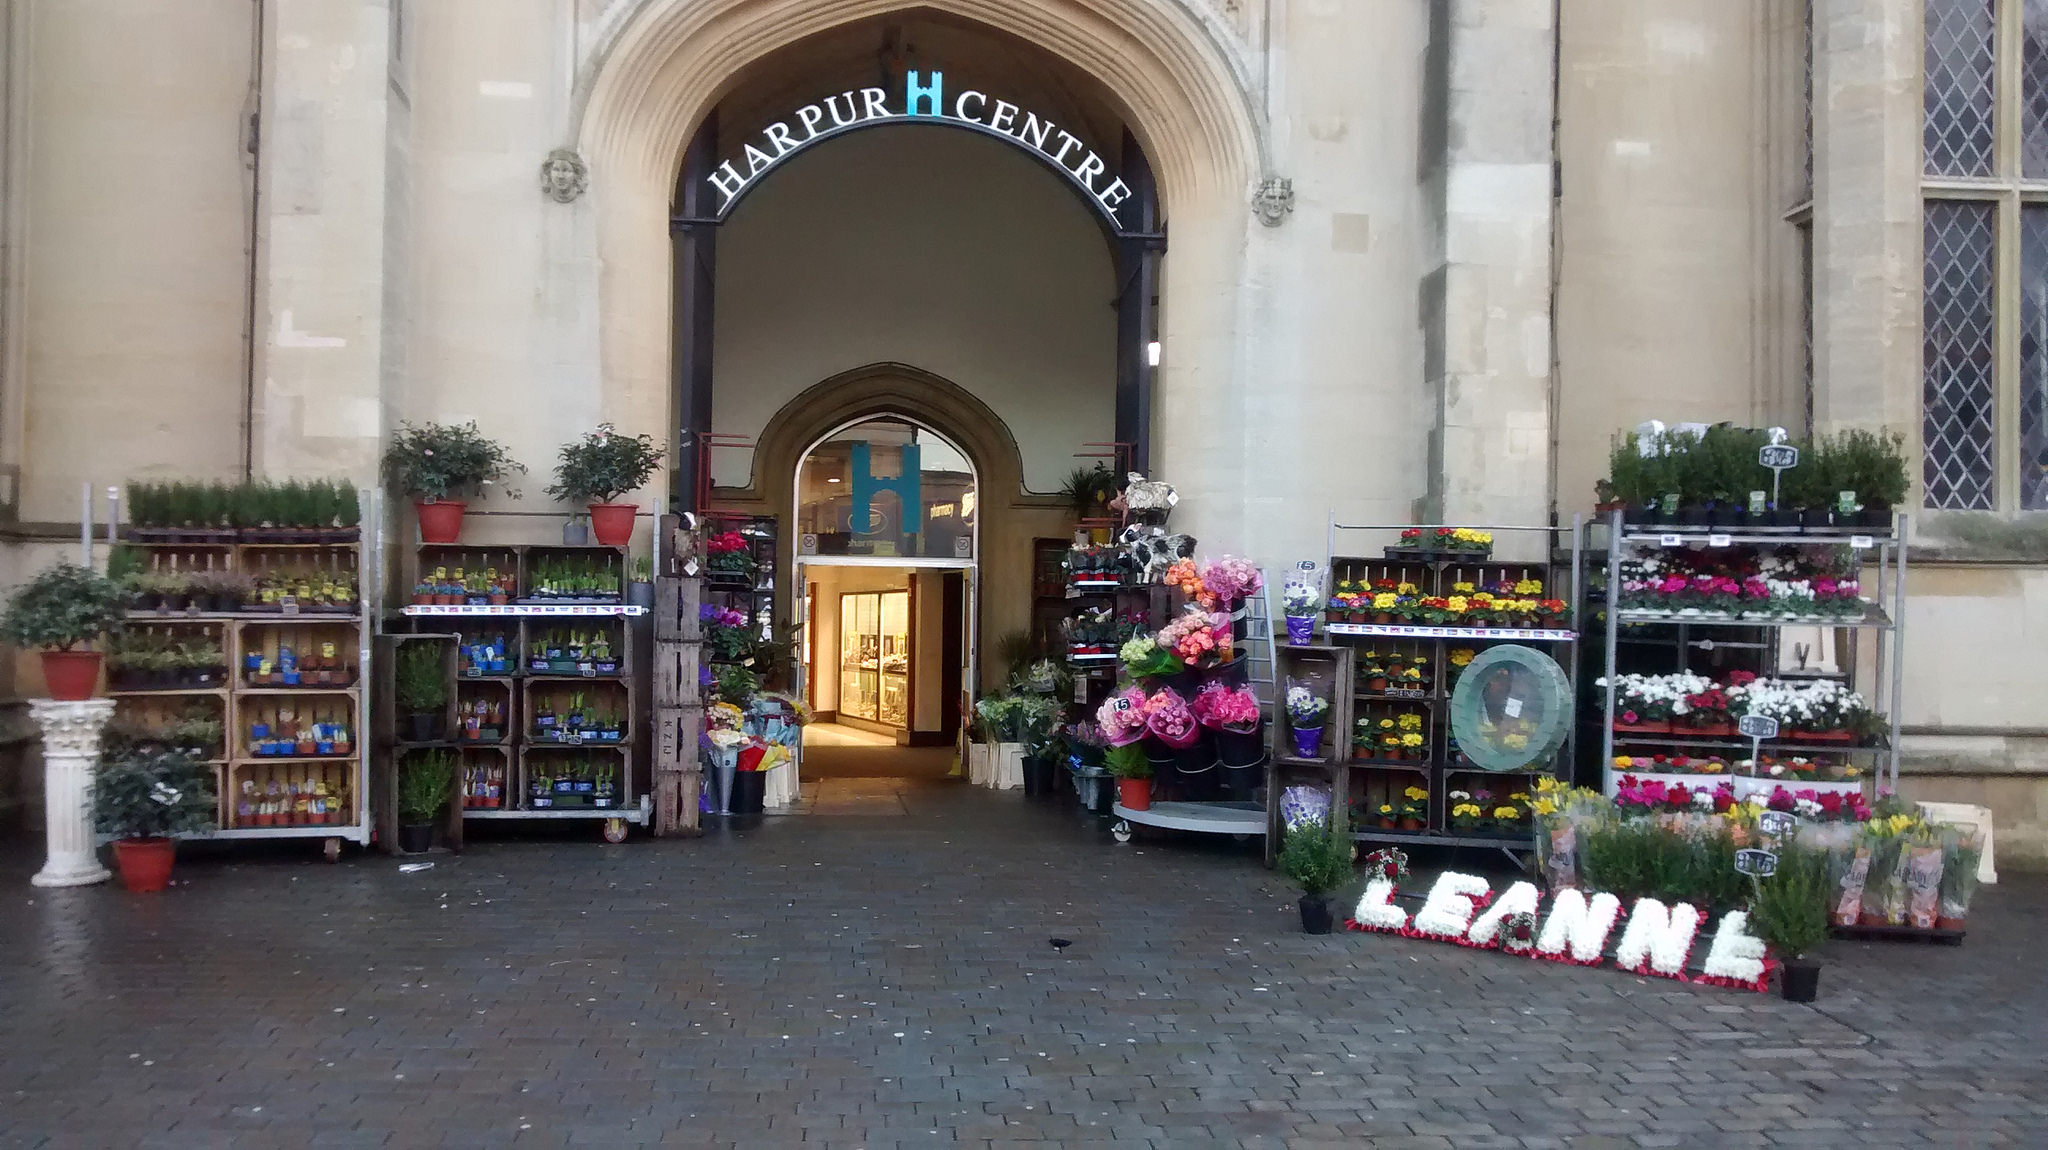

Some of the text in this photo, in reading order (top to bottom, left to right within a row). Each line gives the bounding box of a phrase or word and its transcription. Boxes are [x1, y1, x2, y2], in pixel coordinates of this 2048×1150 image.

[707, 86, 894, 202] HARPUR
[955, 89, 1133, 214] CENTRE
[1114, 699, 1128, 712] 15
[1351, 870, 1770, 987] LEANNE
